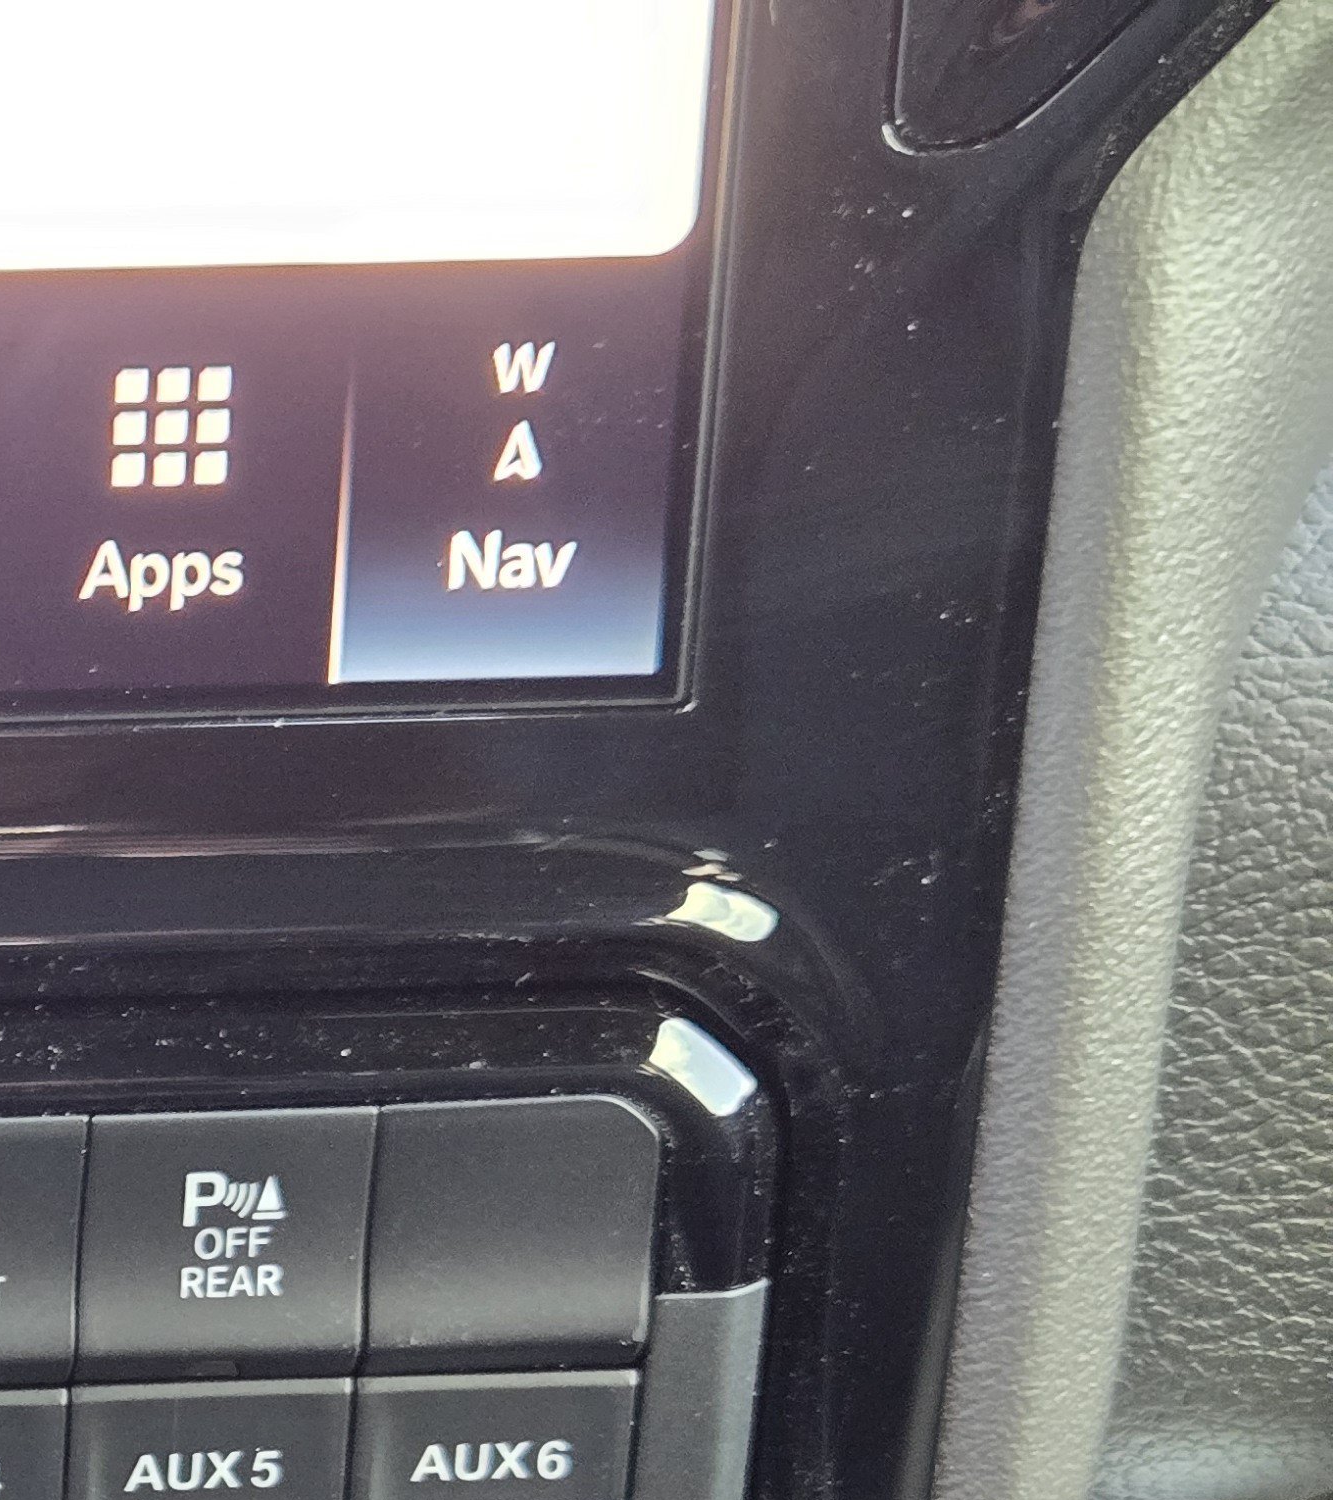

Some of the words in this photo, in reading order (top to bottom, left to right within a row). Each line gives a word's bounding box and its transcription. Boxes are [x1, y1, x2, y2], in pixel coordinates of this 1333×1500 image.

[492, 341, 556, 394] W
[78, 539, 244, 612] Apps
[446, 529, 577, 592] Nav
[194, 1225, 273, 1261] OFF
[179, 1264, 283, 1299] REAR
[123, 1450, 243, 1492] AUX
[250, 1449, 281, 1488] 5
[409, 1440, 532, 1483] AUX
[536, 1439, 571, 1480] 6
